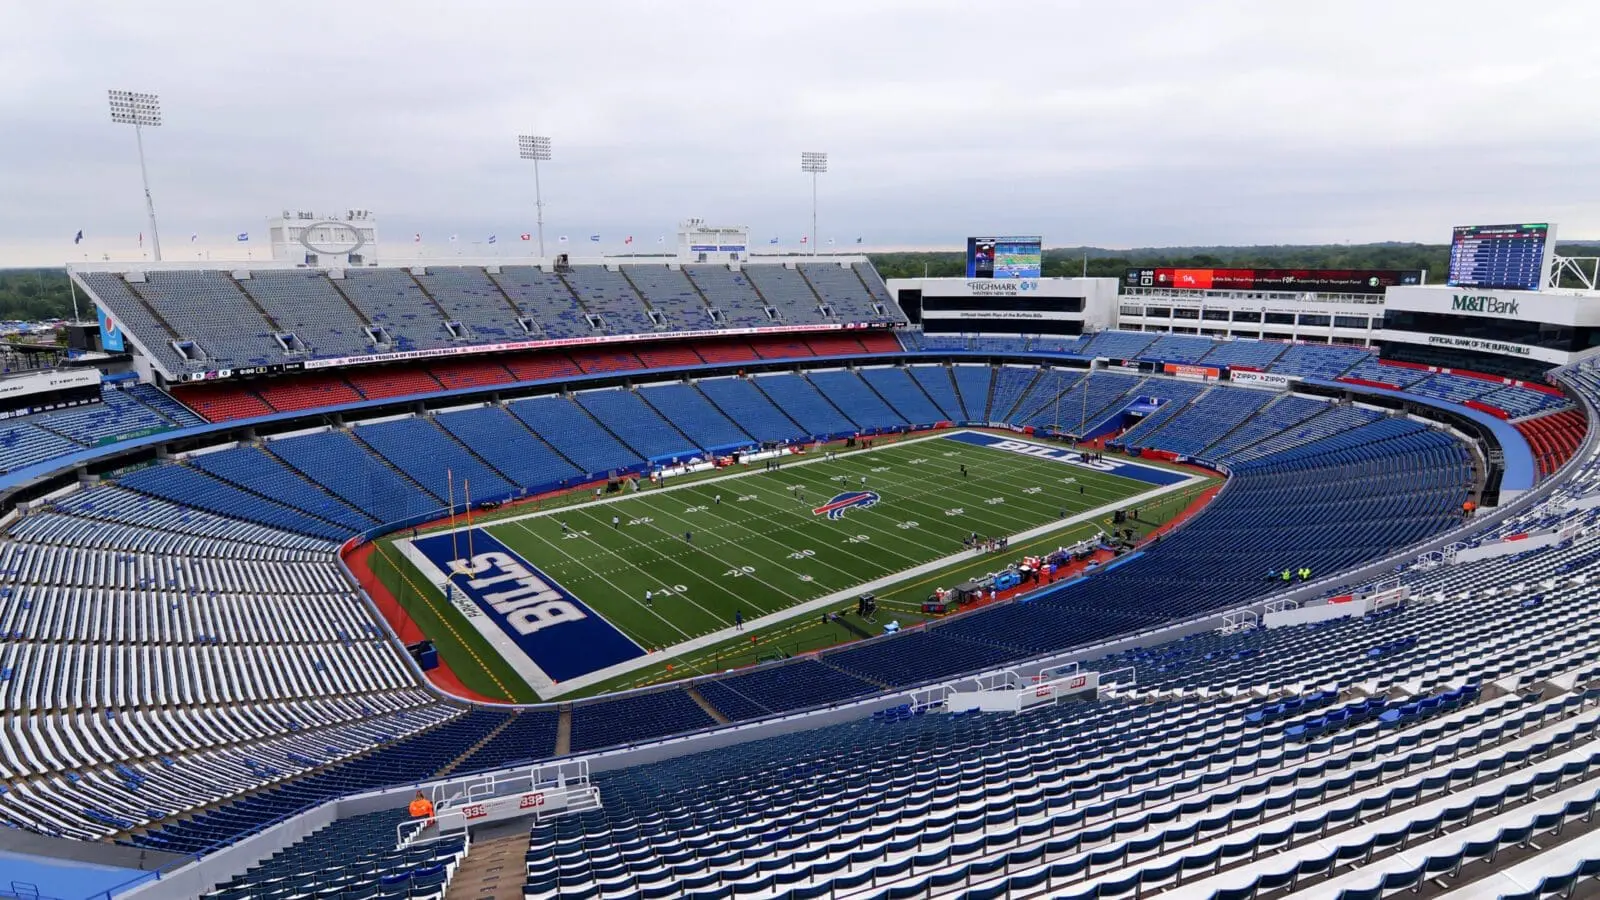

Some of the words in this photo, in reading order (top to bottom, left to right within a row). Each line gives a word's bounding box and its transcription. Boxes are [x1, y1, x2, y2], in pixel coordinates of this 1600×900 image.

[971, 282, 1017, 291] HIGHMARK
[1452, 295, 1488, 311] M&T
[1488, 297, 1520, 315] Bank
[1429, 336, 1453, 344] OFFICIAL
[1480, 341, 1490, 349] THE
[1491, 343, 1516, 352] BUFFALO
[1515, 346, 1530, 355] BILLS
[349, 355, 374, 363] OFFICIAL
[1236, 372, 1257, 380] ZIPPO
[1264, 375, 1286, 384] ZIPPO
[986, 440, 1126, 471] BILLS
[727, 565, 756, 578] 20
[446, 552, 588, 635] BILLS
[662, 584, 688, 598] 10
